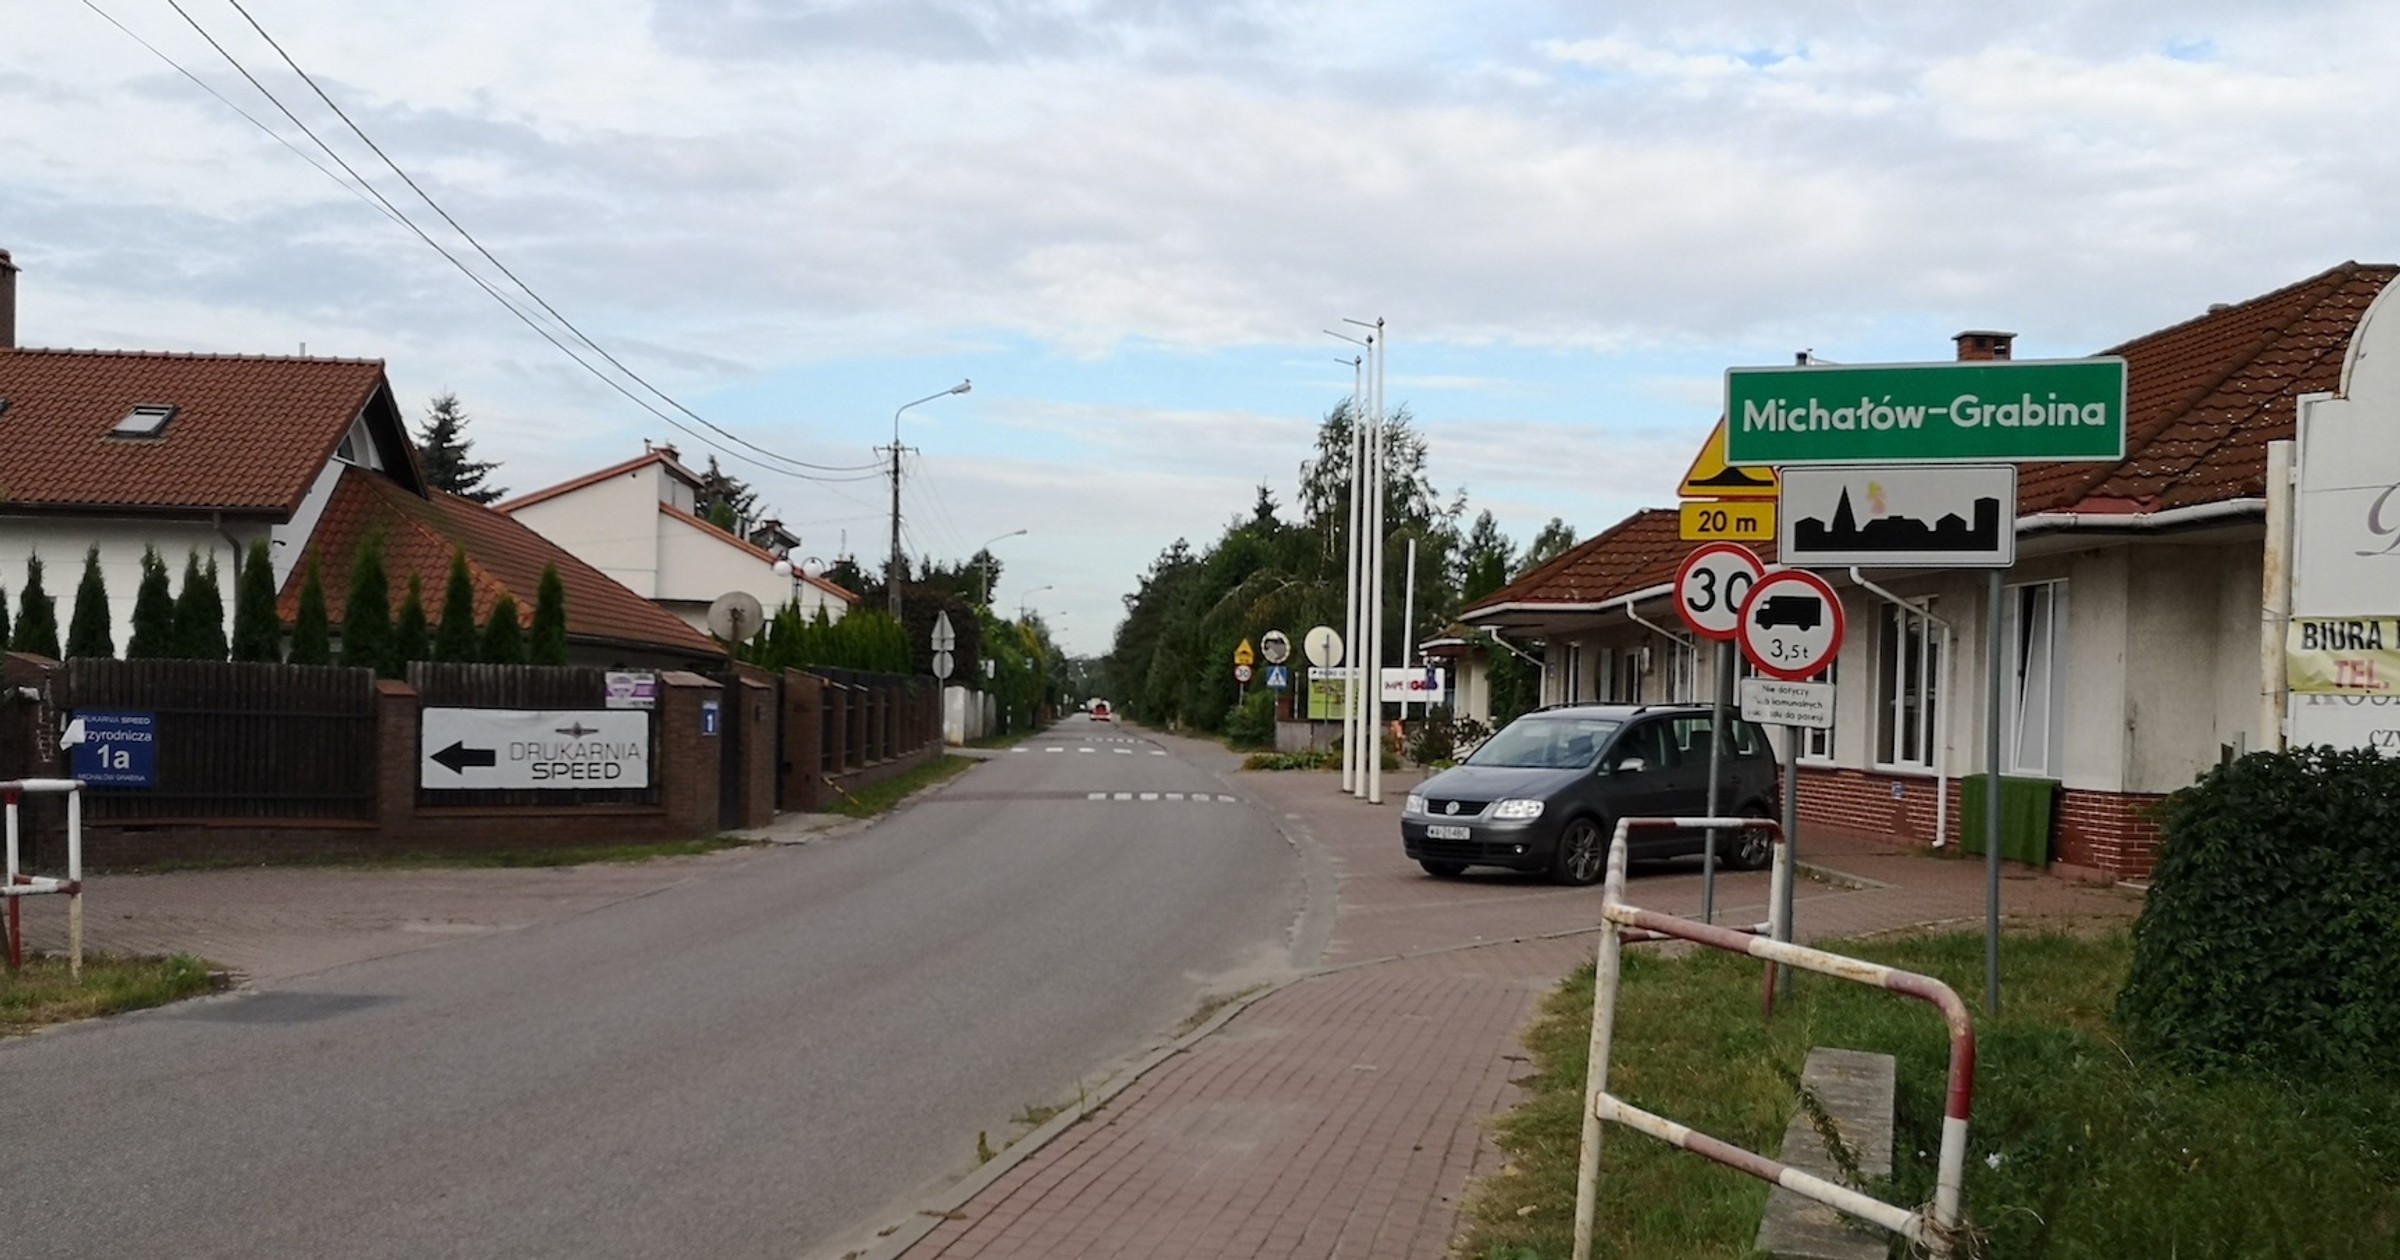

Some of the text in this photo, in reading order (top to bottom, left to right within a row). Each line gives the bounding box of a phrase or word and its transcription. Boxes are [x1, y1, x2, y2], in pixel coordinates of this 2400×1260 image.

[1743, 392, 2106, 432] Michałów-Grabina
[1698, 510, 1757, 532] 20 m
[1687, 567, 1754, 615] 30
[2302, 620, 2383, 650] BIURA
[2333, 659, 2389, 689] TEL.
[1778, 685, 1809, 697] dotyczy
[706, 713, 714, 733] 1
[84, 730, 152, 743] rzyrodnicza
[97, 743, 130, 769] 1a
[510, 741, 642, 761] DRUKARNIA
[531, 762, 622, 780] SPEED
